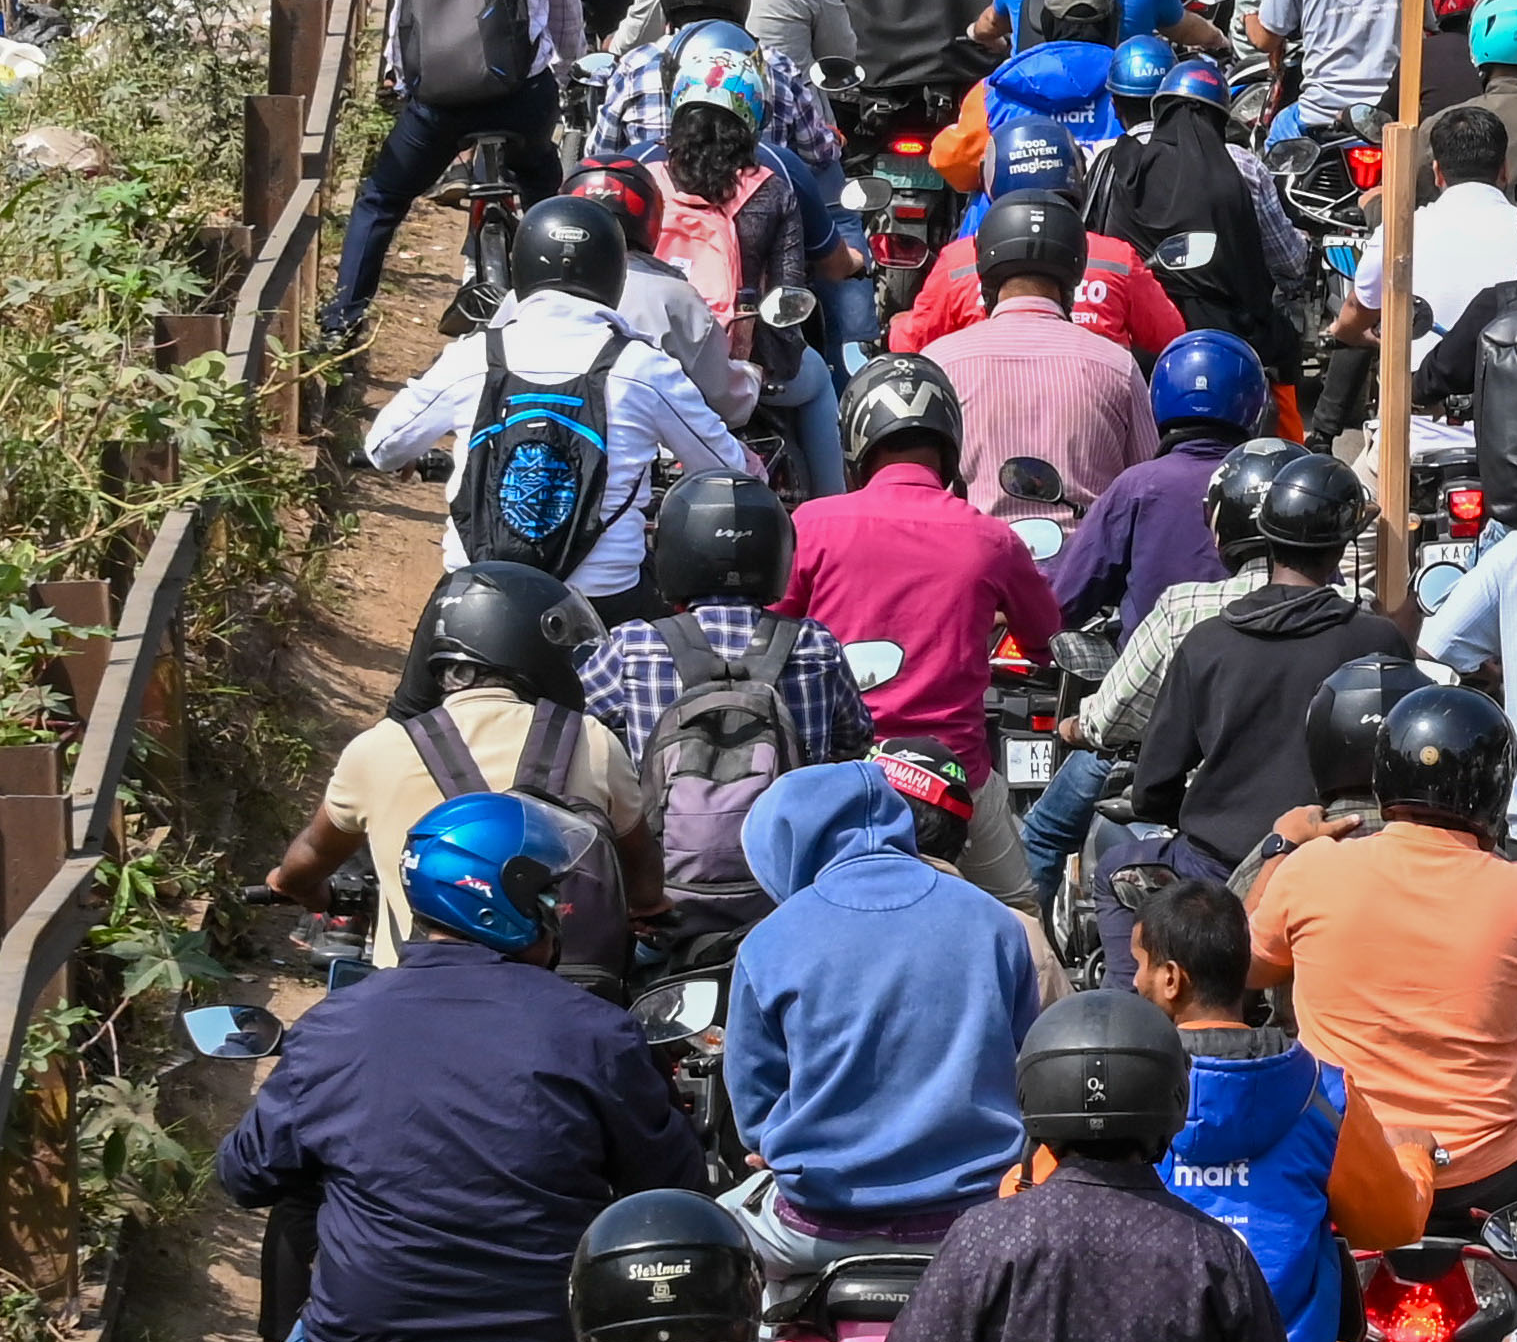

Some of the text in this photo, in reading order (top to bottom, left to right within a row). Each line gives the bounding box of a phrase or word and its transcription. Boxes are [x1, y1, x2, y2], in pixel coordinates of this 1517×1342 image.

[1008, 146, 1058, 160] DELIVERY
[884, 761, 933, 789] YAMAHA
[1174, 1156, 1249, 1187] mart
